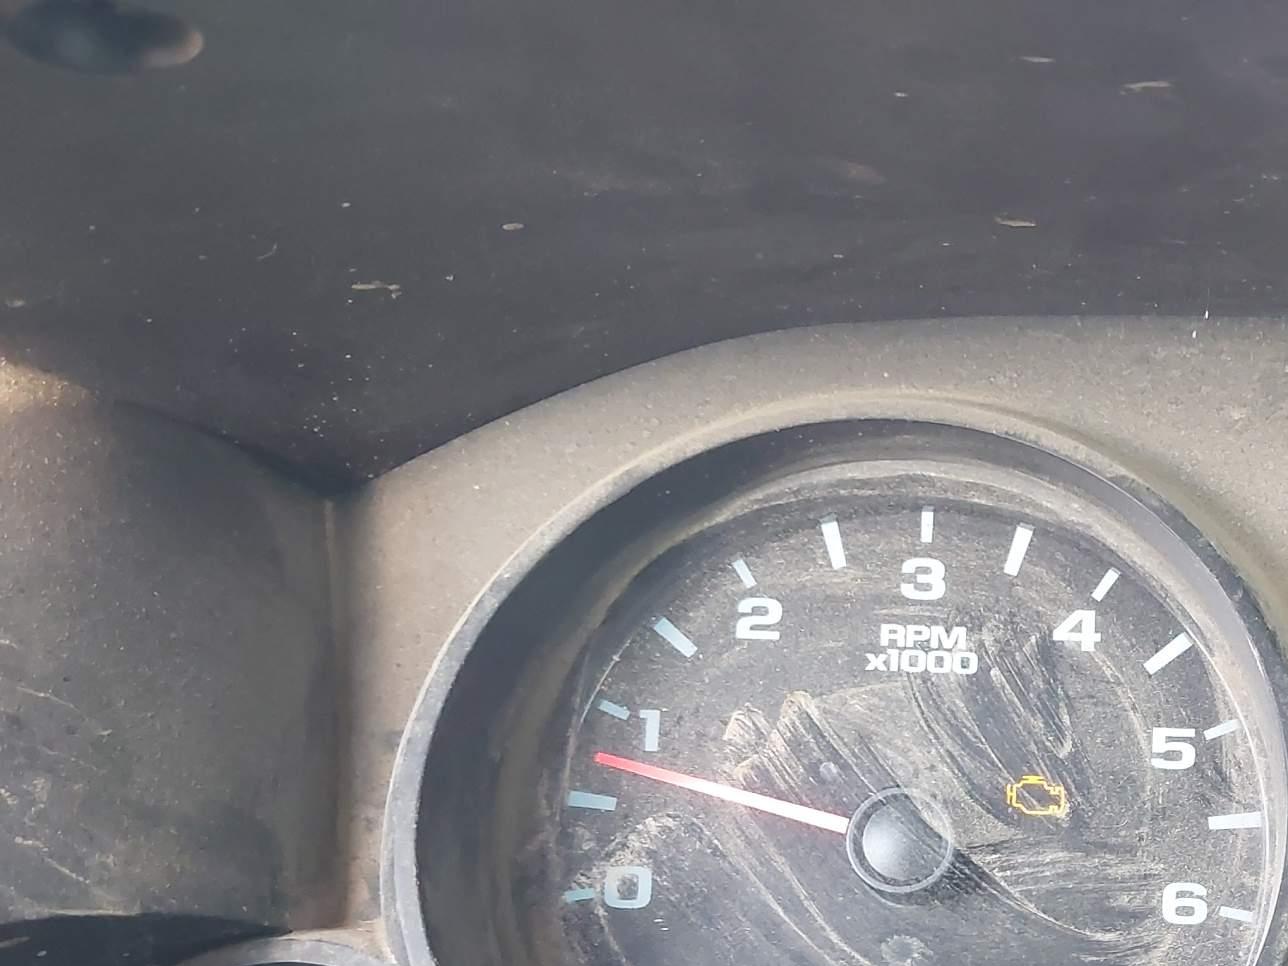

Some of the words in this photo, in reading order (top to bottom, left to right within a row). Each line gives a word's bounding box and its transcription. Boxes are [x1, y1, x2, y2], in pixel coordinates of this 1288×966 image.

[899, 557, 946, 600] 3
[735, 598, 784, 641] 2
[879, 622, 967, 650] RPM
[1052, 609, 1101, 652] 4
[864, 650, 978, 676] x1000
[638, 709, 660, 752] 1
[1150, 727, 1197, 770] 5
[603, 866, 653, 910] 0
[1162, 882, 1209, 925] 6
